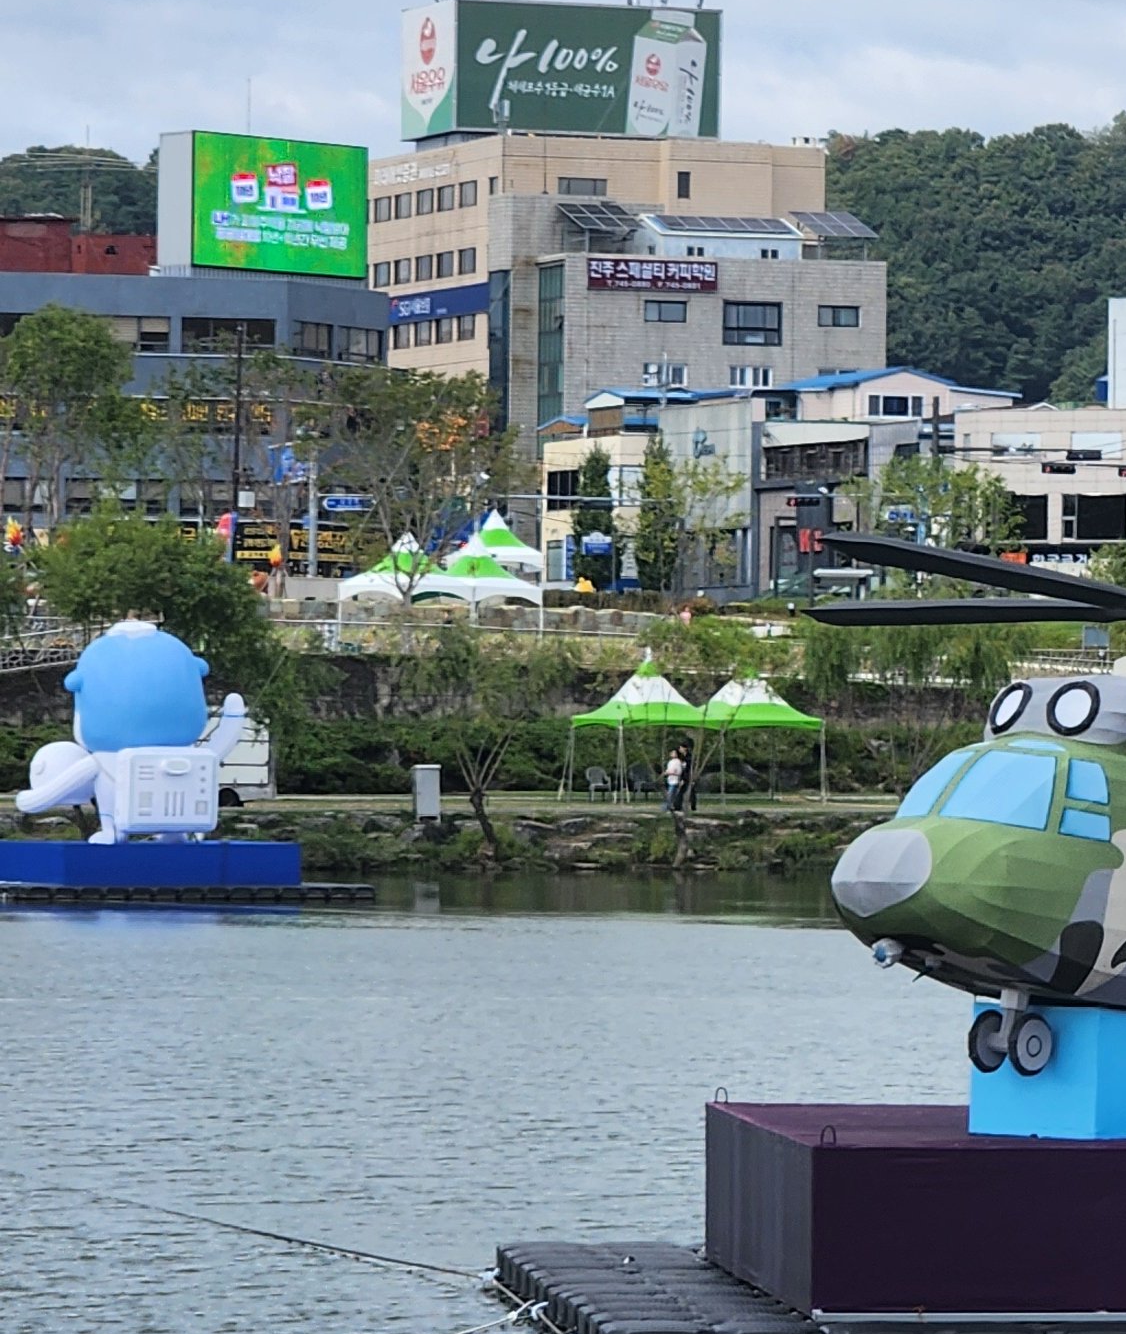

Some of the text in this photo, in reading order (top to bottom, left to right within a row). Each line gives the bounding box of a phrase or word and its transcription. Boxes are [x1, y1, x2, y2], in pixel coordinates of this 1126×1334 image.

[537, 39, 619, 73] 100%
[590, 261, 614, 278] 진주
[667, 263, 716, 281] 커피학원
